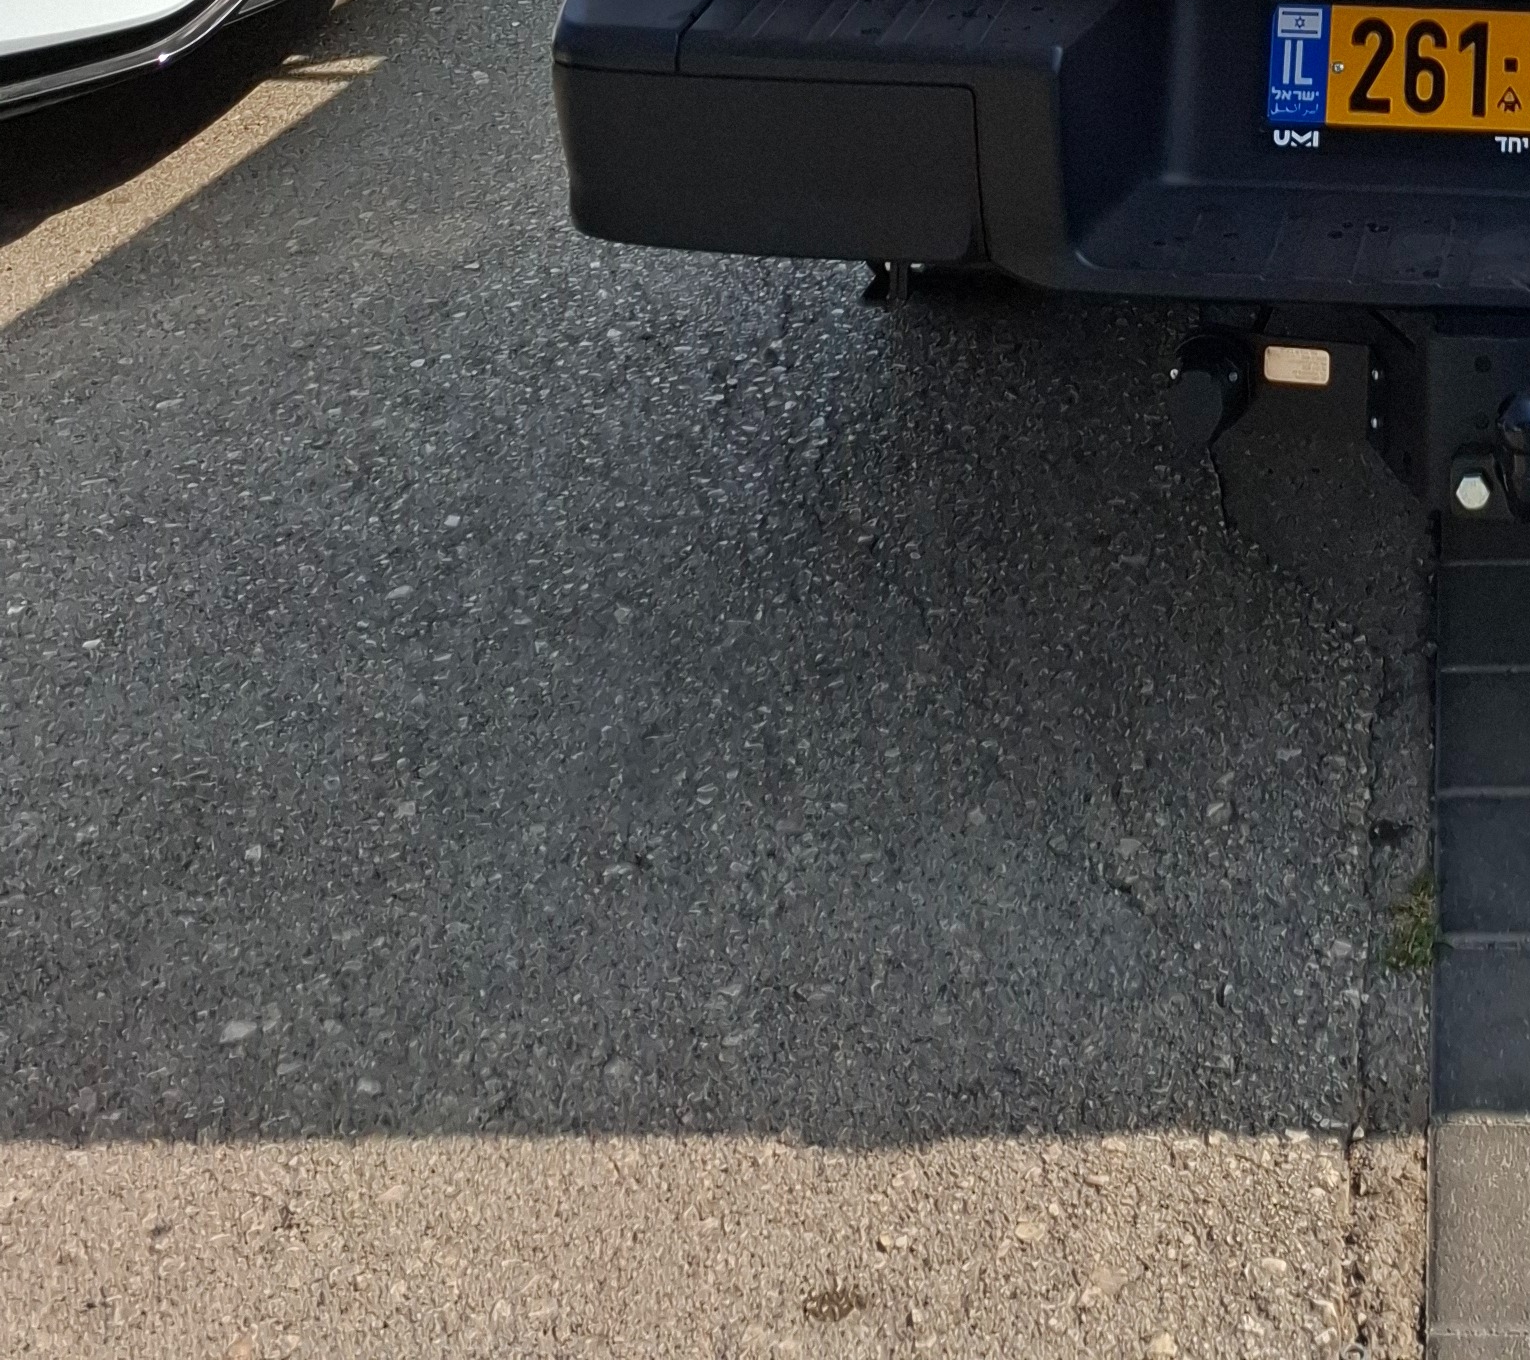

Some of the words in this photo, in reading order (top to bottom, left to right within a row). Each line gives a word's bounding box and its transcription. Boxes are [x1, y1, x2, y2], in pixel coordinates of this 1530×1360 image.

[1282, 39, 1313, 86] IL
[1271, 86, 1320, 101] ישראל
[1273, 129, 1320, 148] UMI
[1494, 136, 1529, 154] יחד
